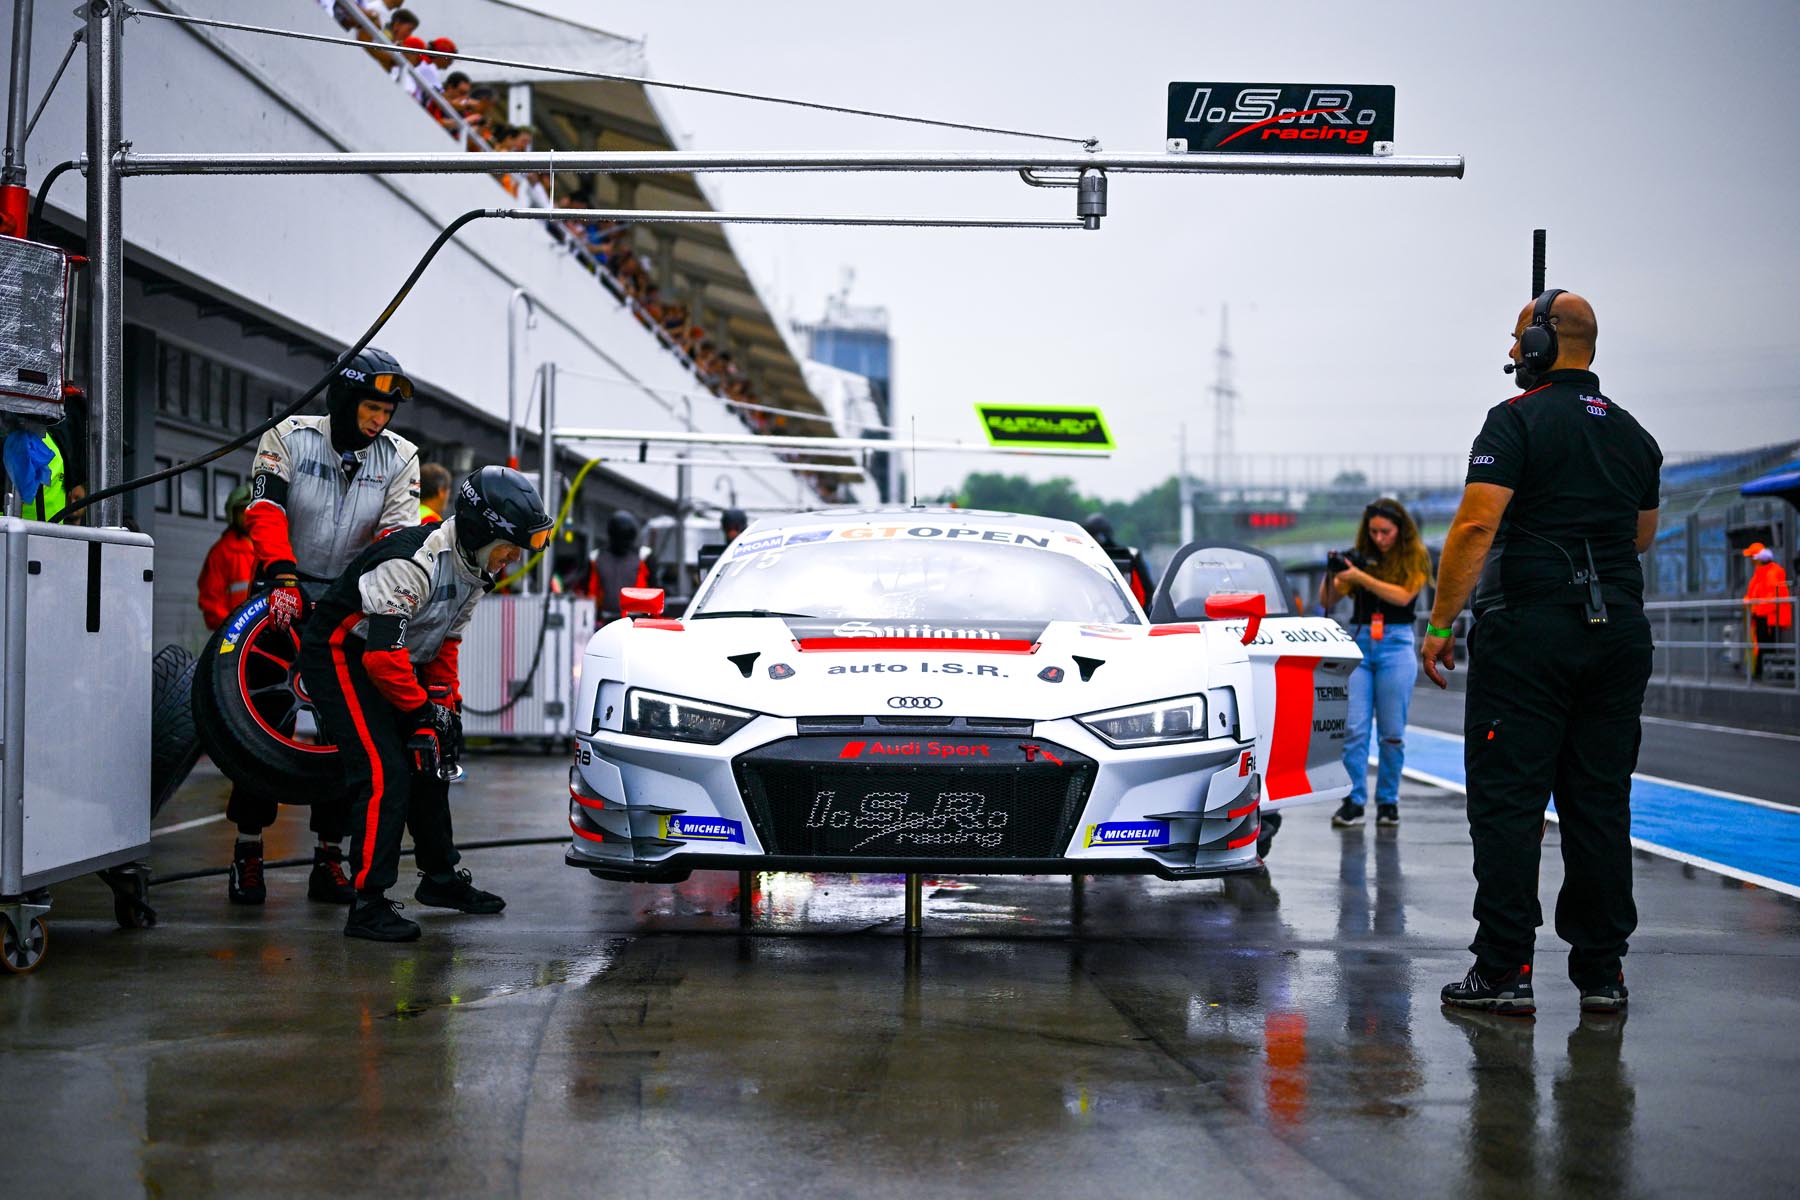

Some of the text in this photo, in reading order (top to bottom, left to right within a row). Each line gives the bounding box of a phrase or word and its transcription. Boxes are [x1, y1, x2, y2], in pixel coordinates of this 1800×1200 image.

[1260, 126, 1369, 144] racing
[254, 475, 266, 498] 3
[1281, 628, 1327, 642] auto
[827, 662, 1009, 678] auto I.S.R.
[869, 742, 990, 758] Audi Sport
[683, 823, 736, 836] MICHELIN
[1104, 828, 1160, 839] MICHELIN
[895, 829, 1005, 848] racing
